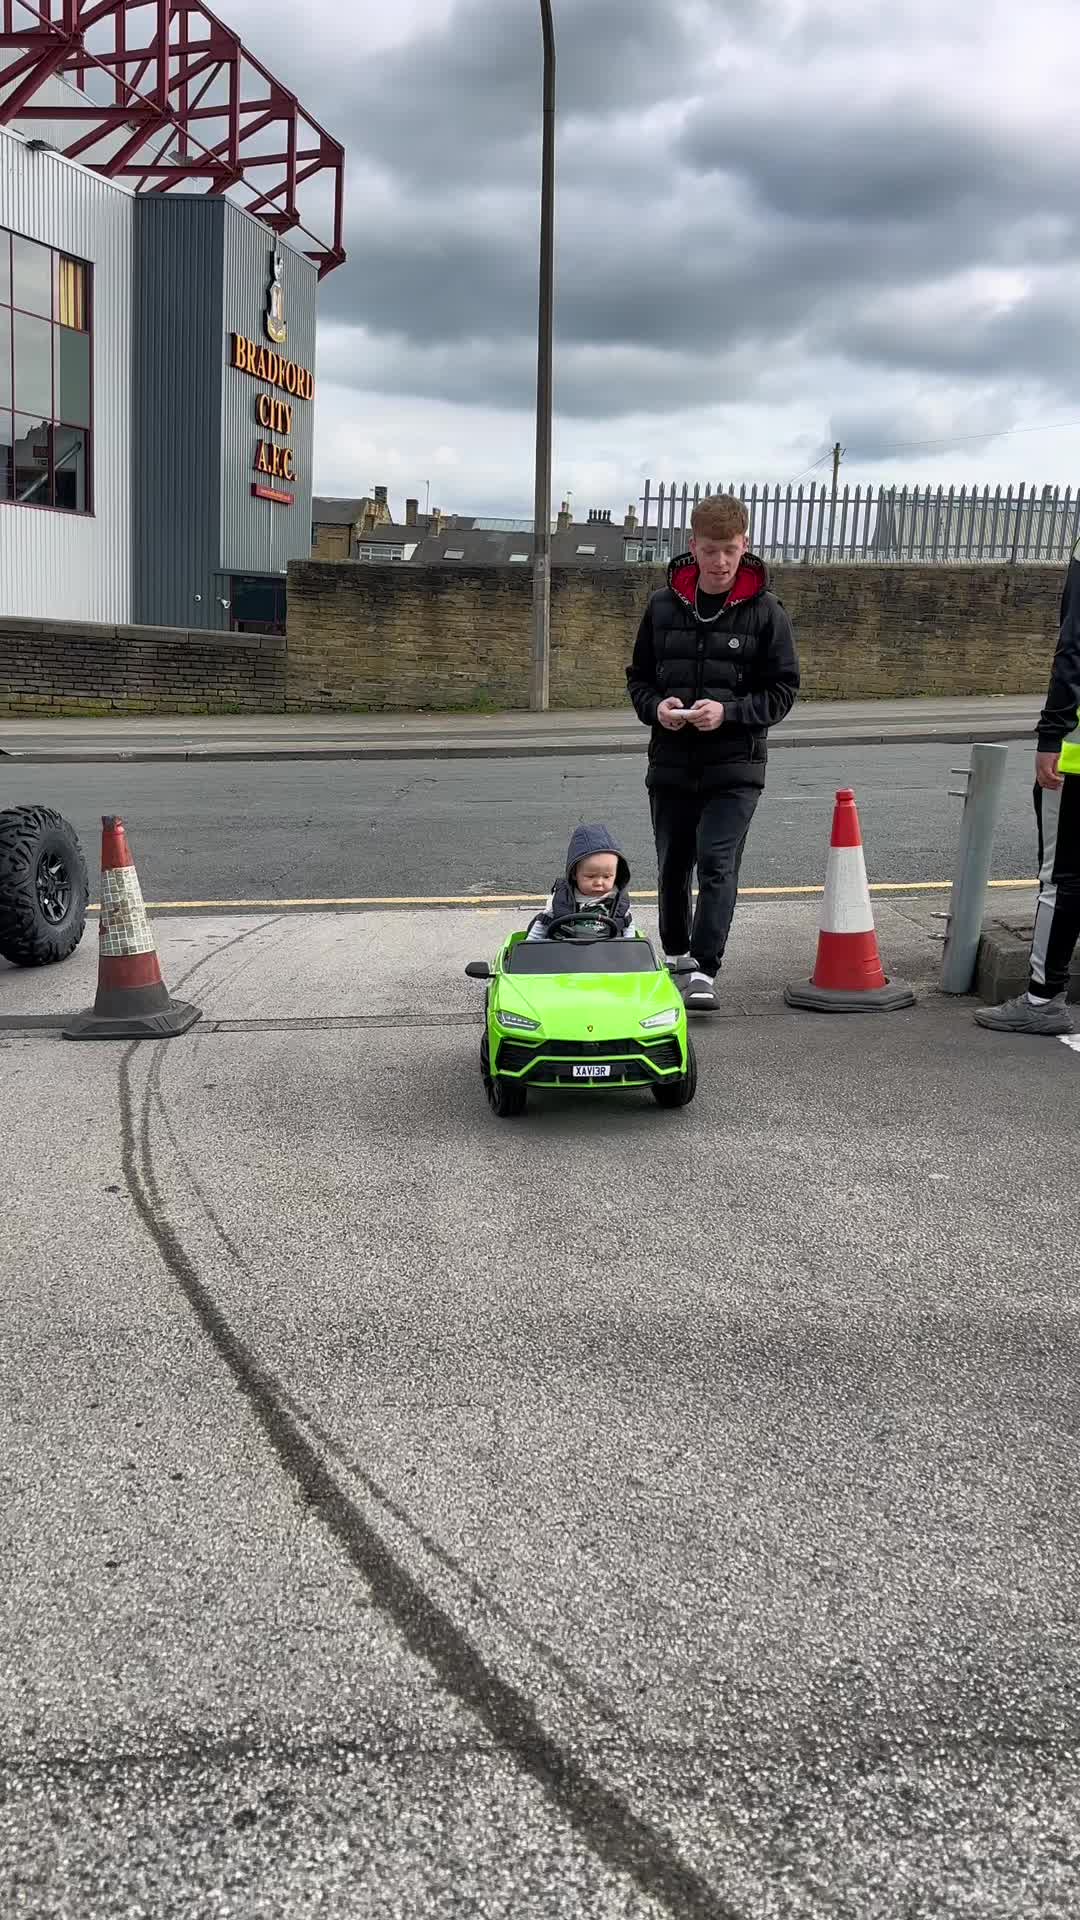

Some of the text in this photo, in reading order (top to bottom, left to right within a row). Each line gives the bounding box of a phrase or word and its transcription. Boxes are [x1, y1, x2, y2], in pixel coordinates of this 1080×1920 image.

[234, 334, 315, 400] BRADFORD
[258, 393, 293, 434] CITY
[257, 440, 298, 481] A.F.C.
